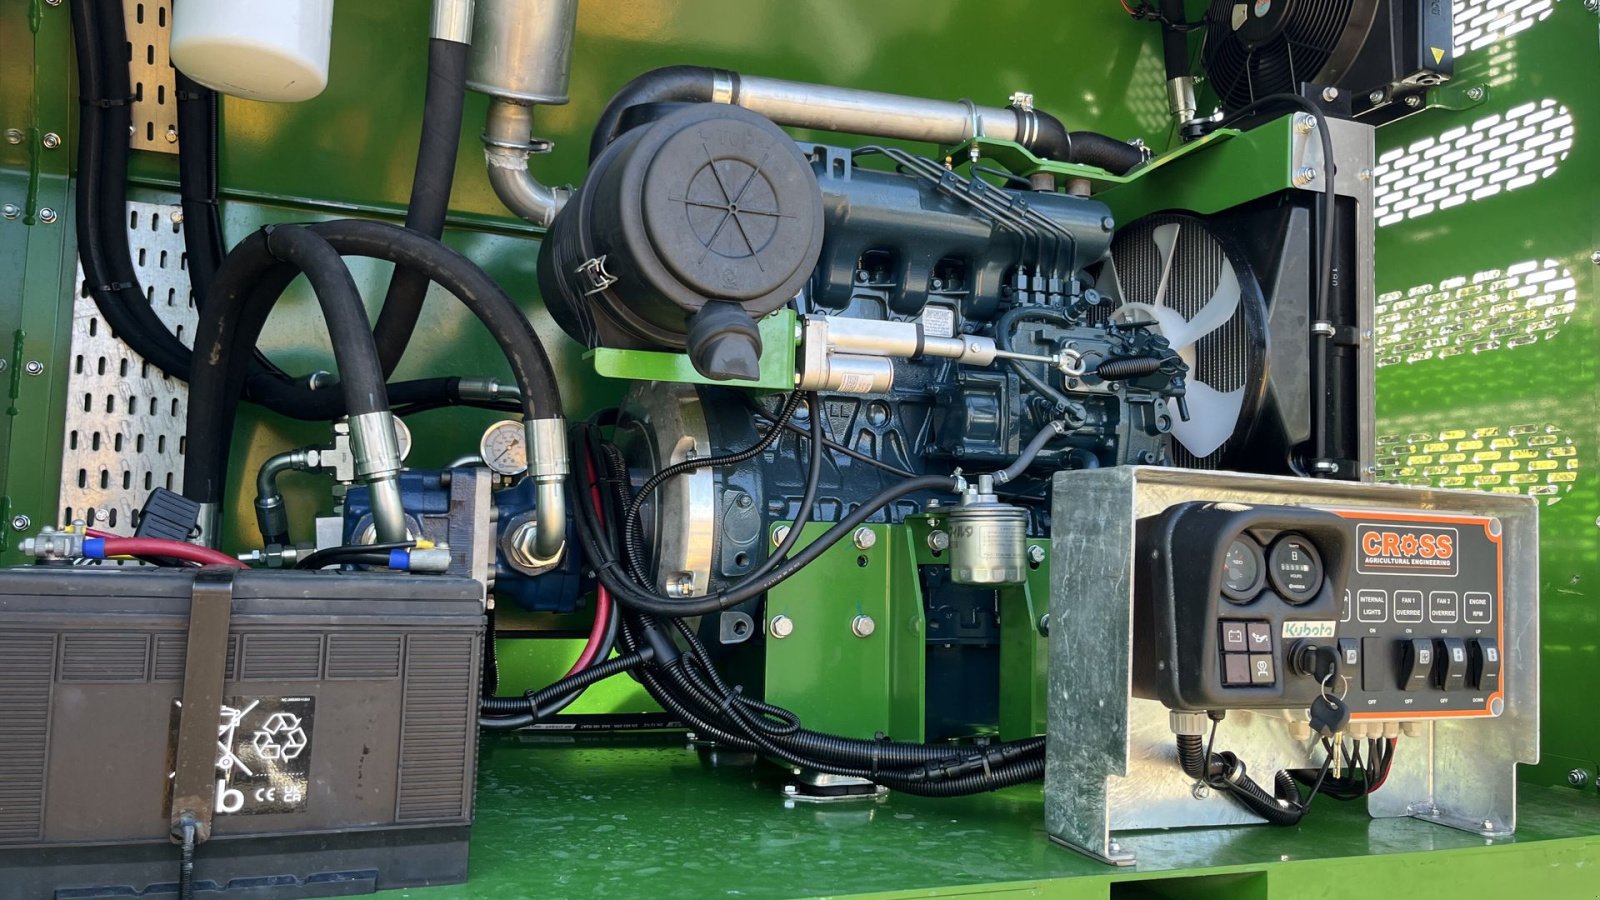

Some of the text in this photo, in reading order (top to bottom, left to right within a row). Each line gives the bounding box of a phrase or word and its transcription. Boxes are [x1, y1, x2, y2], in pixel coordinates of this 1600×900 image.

[1362, 531, 1453, 559] CROSS
[1365, 557, 1451, 566] AGRICULTURAL ENGINEERING
[1285, 623, 1333, 636] Kubota
[255, 788, 275, 802] CE
[283, 794, 301, 802] CA
